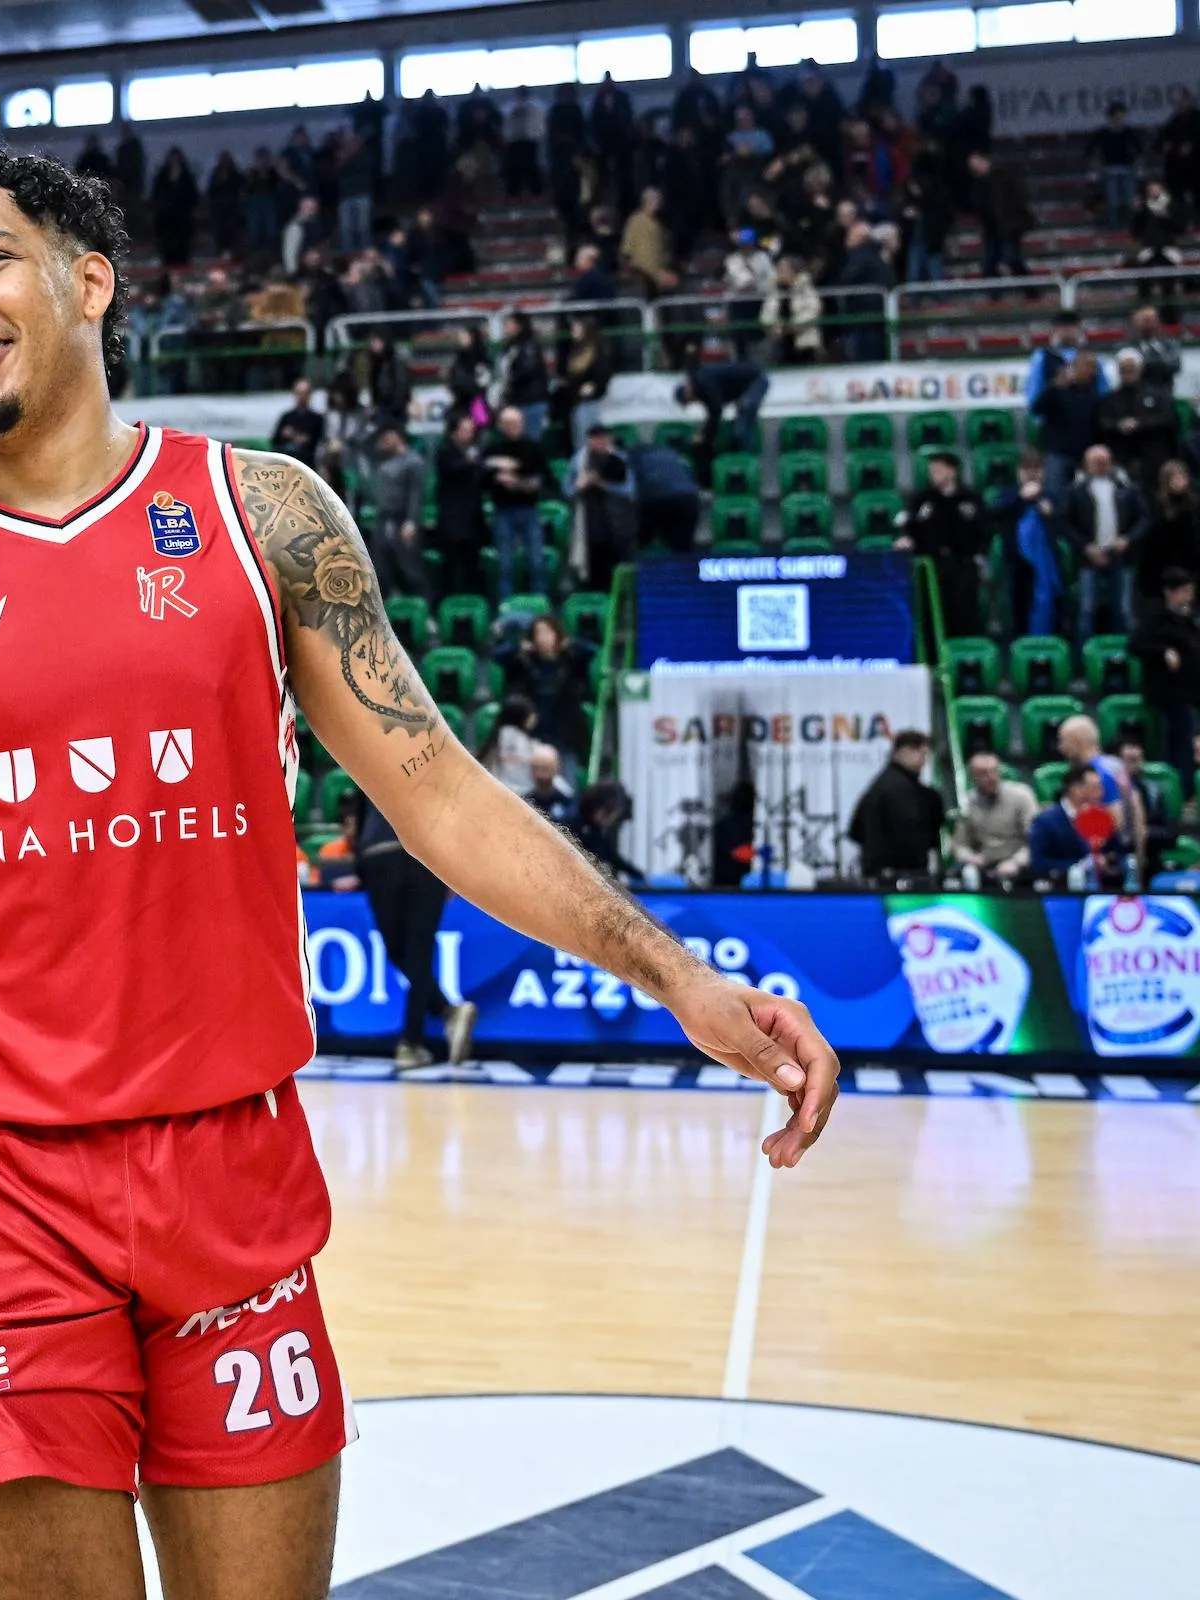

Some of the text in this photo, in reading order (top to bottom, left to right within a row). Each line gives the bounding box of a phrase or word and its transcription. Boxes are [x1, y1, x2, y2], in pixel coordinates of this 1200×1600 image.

[845, 374, 1019, 402] SARDEGN
[254, 470, 286, 481] 1997
[155, 518, 191, 529] LBA
[164, 539, 194, 550] Unipol
[653, 713, 893, 745] SARDEGNA
[68, 802, 248, 853] HOTELS
[213, 1329, 321, 1433] 26
